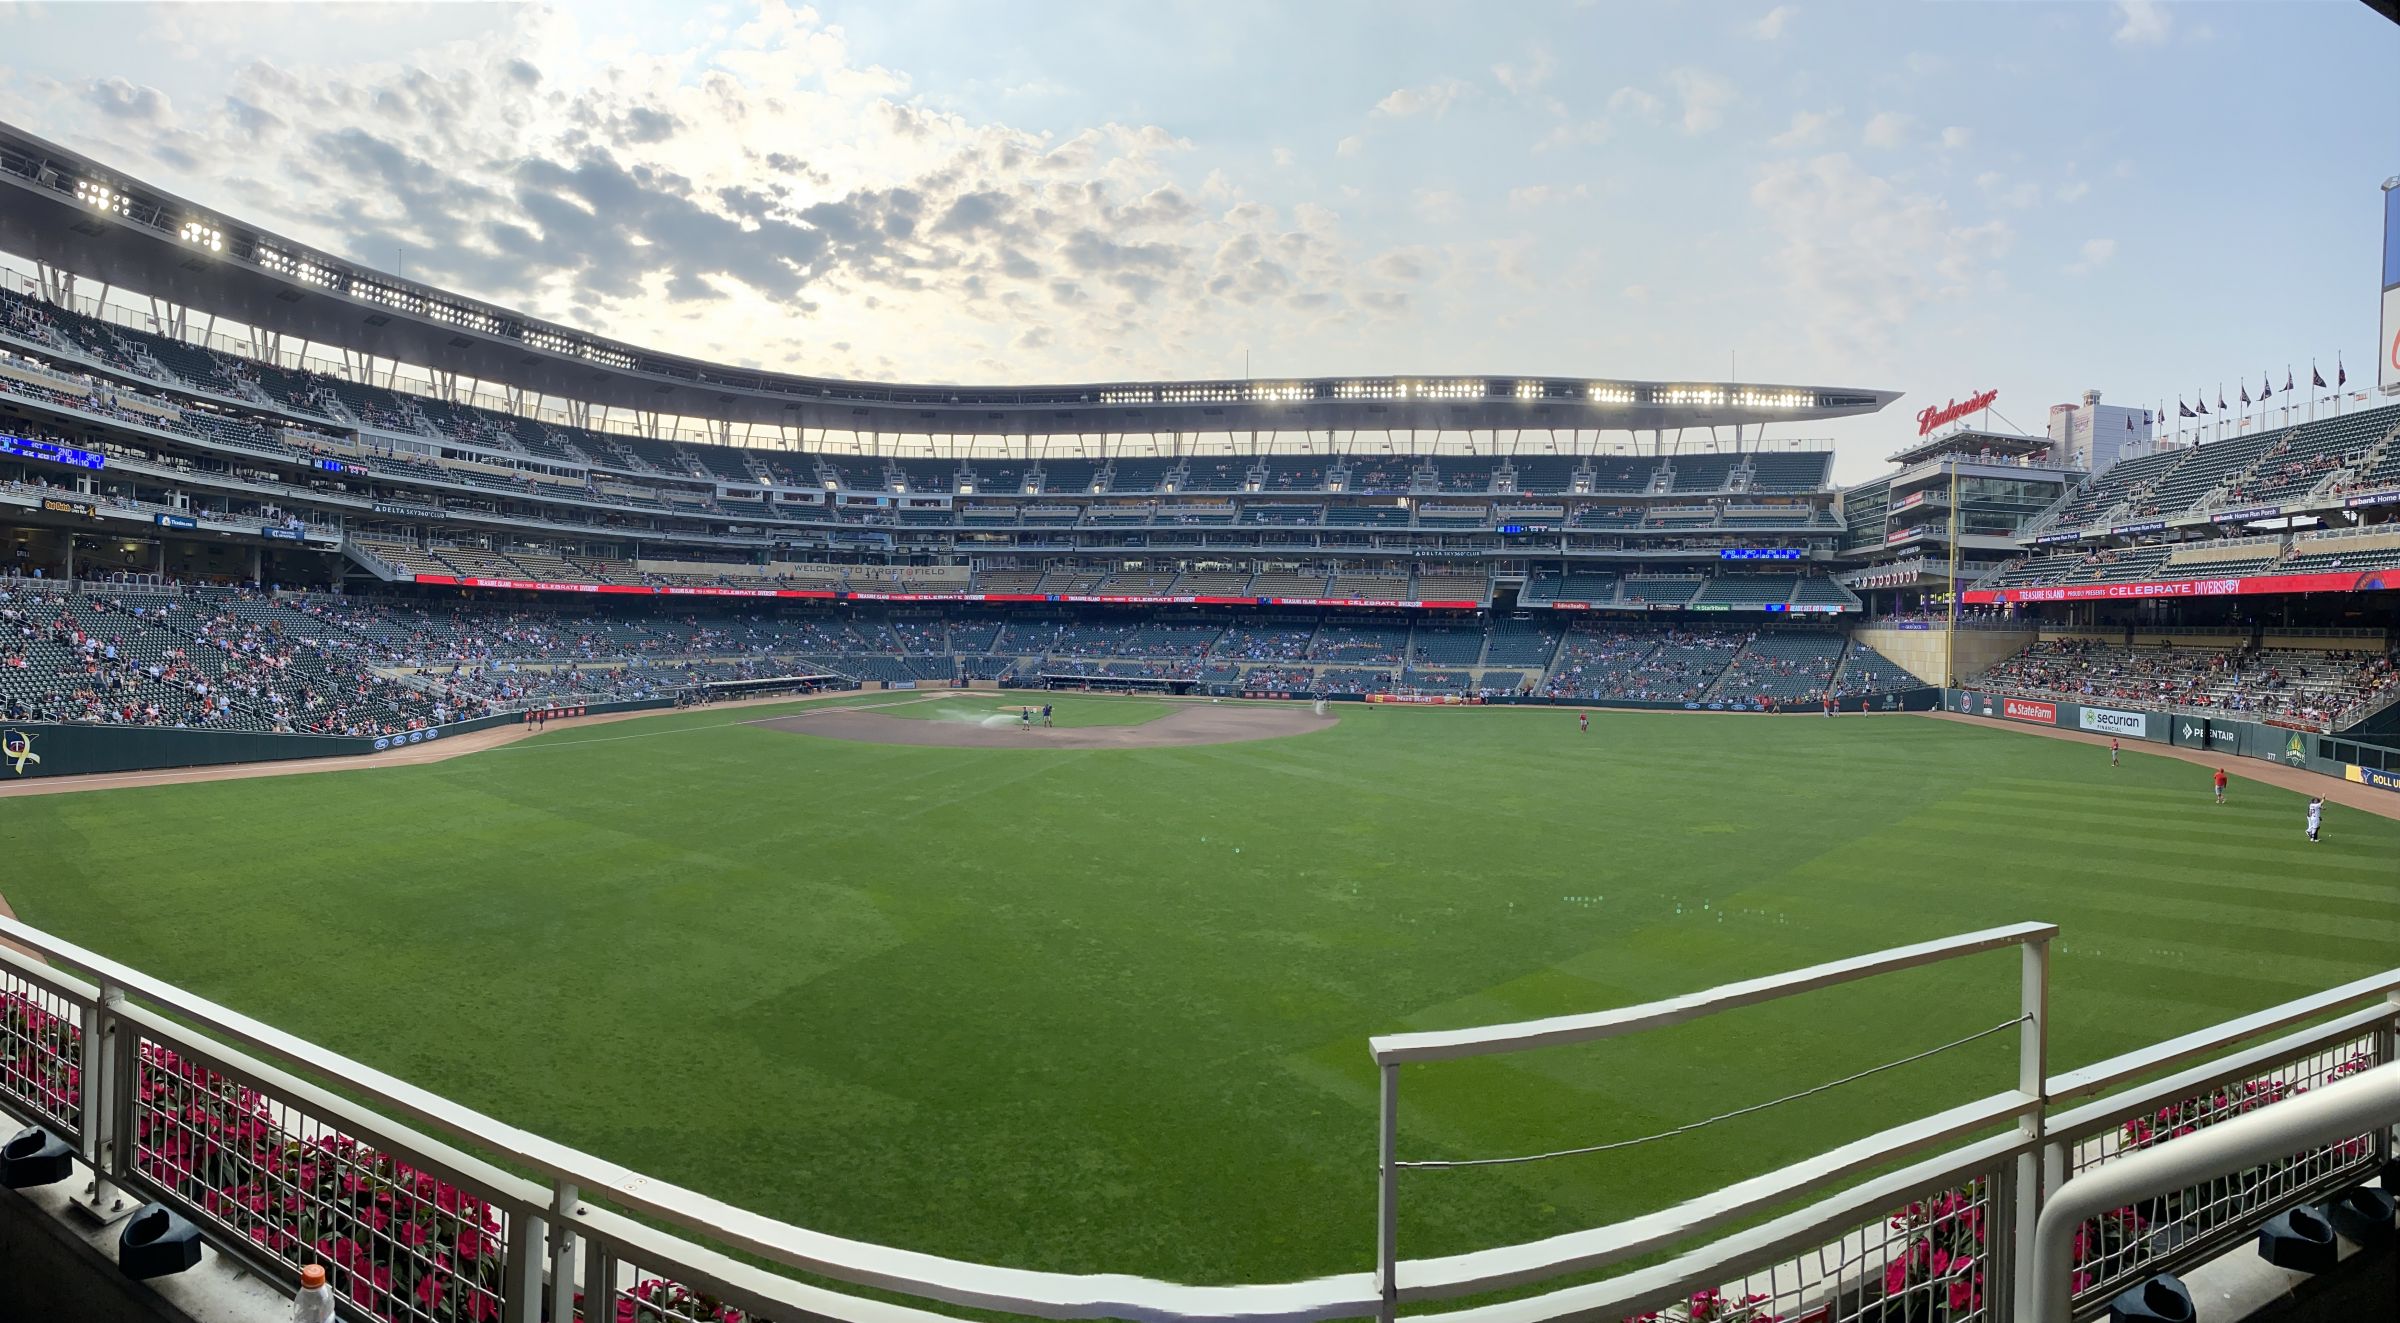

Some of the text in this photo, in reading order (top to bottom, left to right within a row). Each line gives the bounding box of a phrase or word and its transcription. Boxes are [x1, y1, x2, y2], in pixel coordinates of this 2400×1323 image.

[1916, 388, 1998, 436] Budweiser
[58, 448, 73, 457] 2ND
[66, 456, 78, 465] DH
[86, 453, 100, 462] 3RD
[383, 506, 404, 514] DELTA
[794, 565, 848, 573] WELCOME
[535, 583, 579, 591] CELEBRATE
[2019, 590, 2045, 600] TREASURE
[2045, 589, 2065, 599] ISLAND
[2109, 584, 2191, 595] CELEBRATE
[2097, 713, 2139, 728] securian
[2267, 752, 2276, 760] 377
[2374, 774, 2392, 787] ROLL
